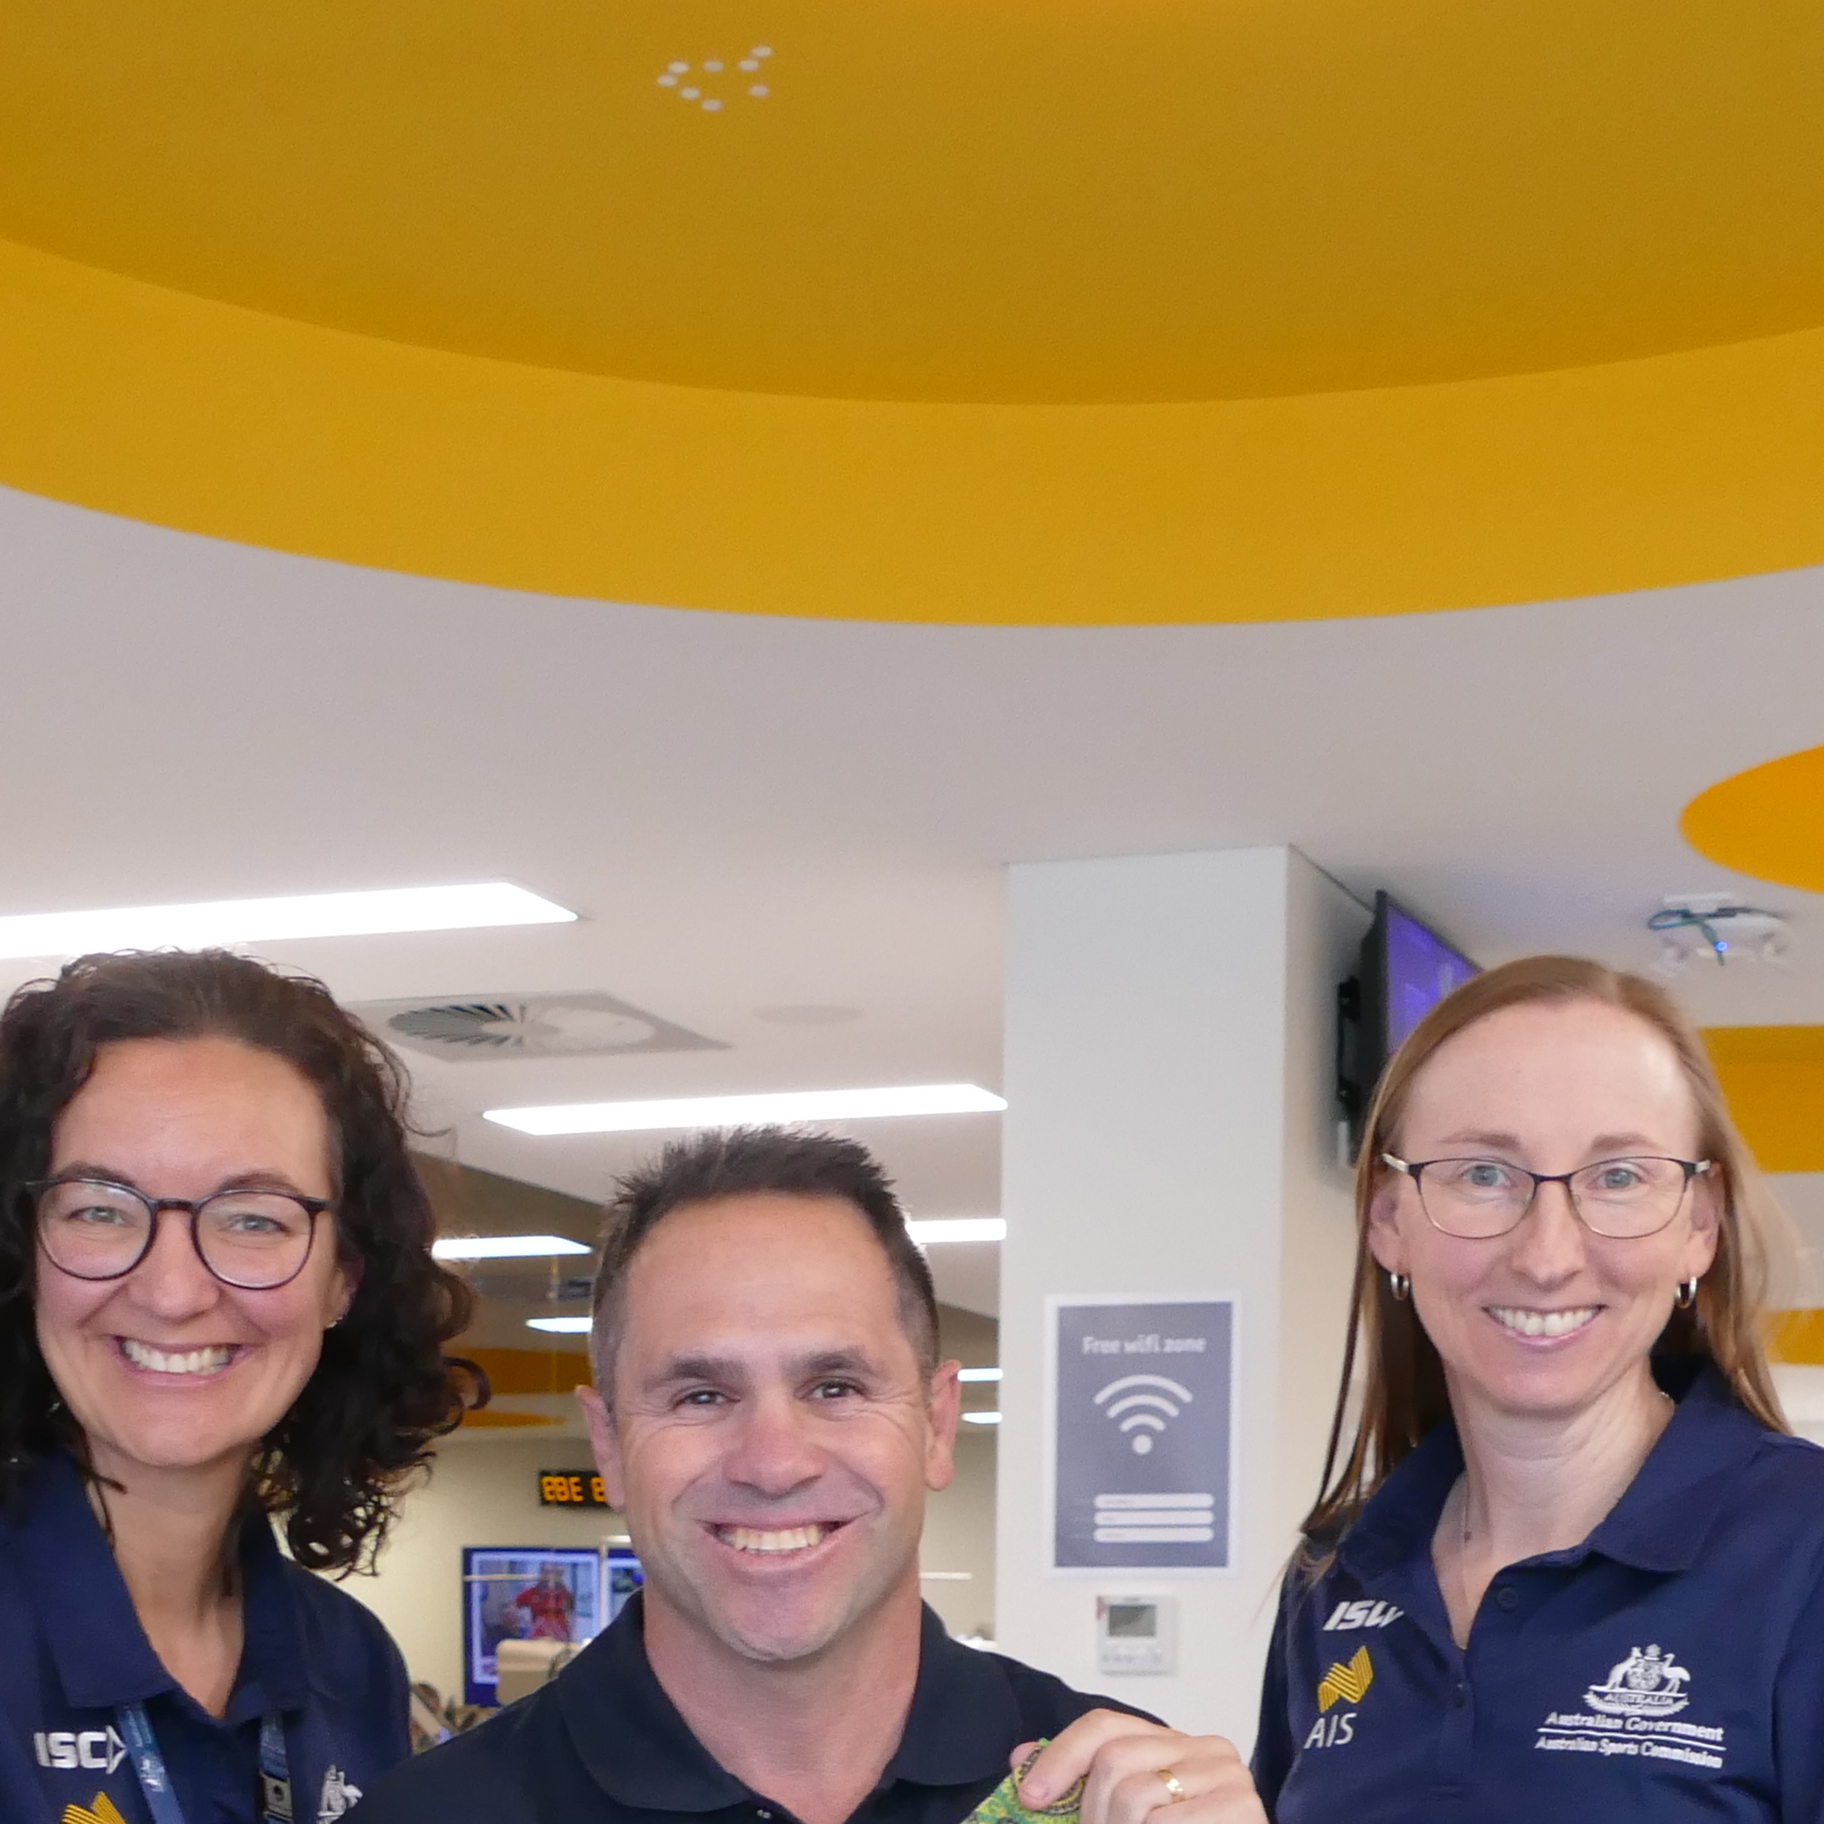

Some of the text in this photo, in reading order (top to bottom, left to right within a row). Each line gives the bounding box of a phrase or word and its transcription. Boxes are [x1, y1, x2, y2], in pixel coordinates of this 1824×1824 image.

[1082, 1335, 1121, 1354] Free
[1303, 1712, 1358, 1750] AIS
[1543, 1711, 1725, 1742] Australian Government
[1533, 1735, 1724, 1770] Australian Sports Commission
